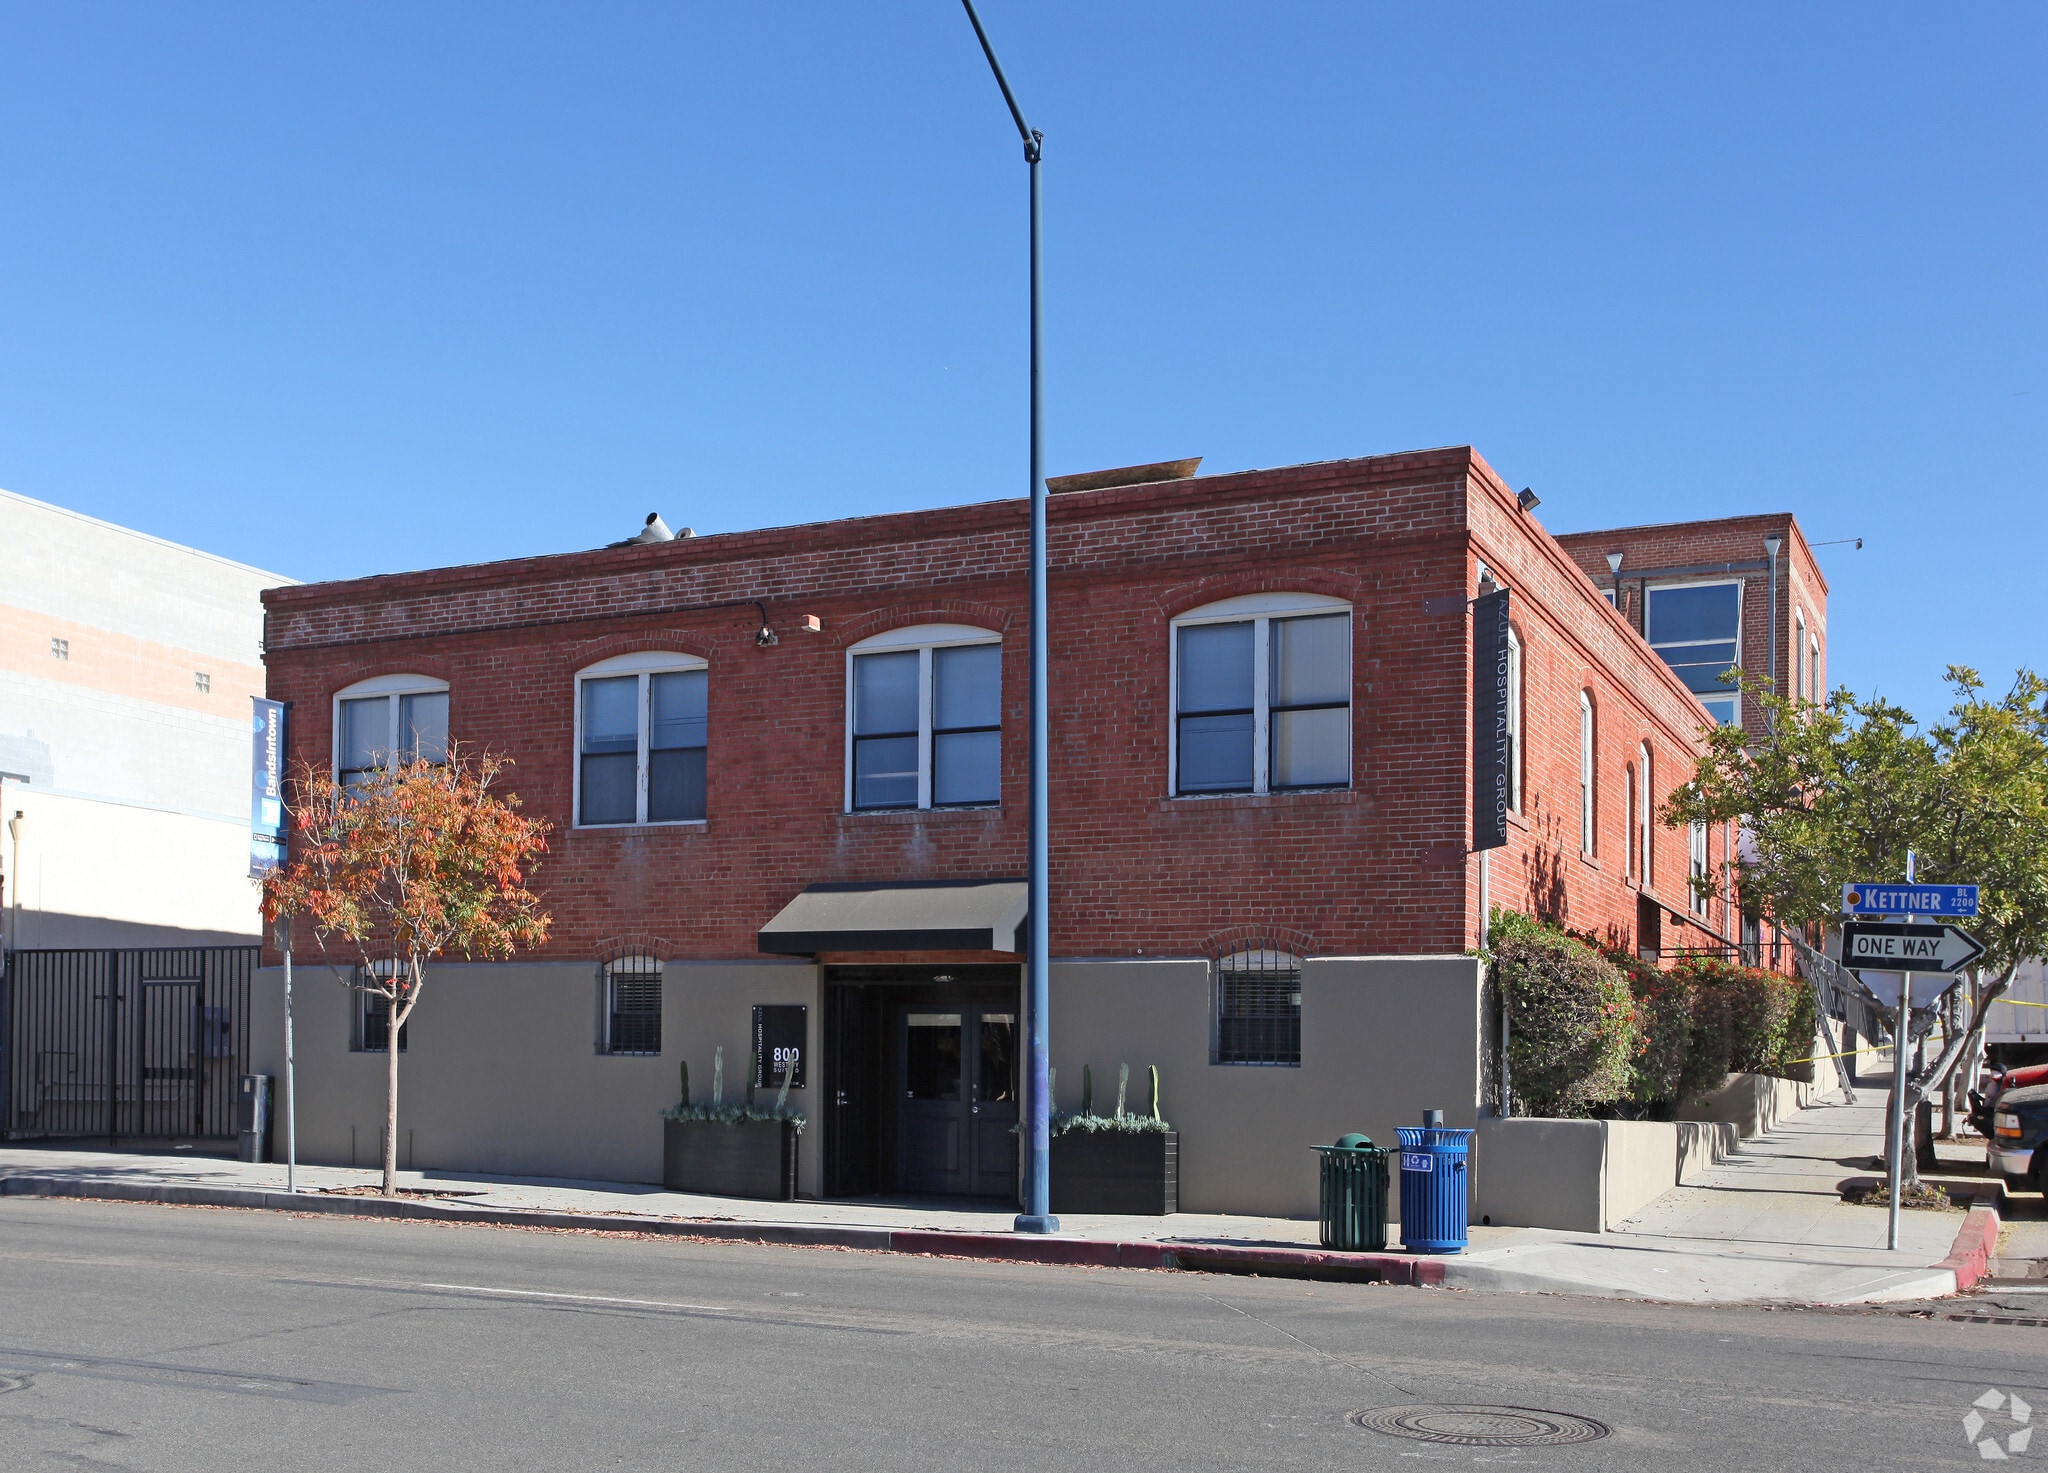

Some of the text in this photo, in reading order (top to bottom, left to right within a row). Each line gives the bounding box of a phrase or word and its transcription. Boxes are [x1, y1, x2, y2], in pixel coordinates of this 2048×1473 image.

[1495, 599, 1509, 838] AZUL HOSPITALITY GROUP
[266, 709, 277, 797] Bandsintown
[1865, 888, 1941, 910] KETTNER
[1957, 888, 1968, 897] BL
[1951, 898, 1974, 907] 2200
[1857, 937, 1941, 956] ONE WAY
[773, 1047, 799, 1062] 800
